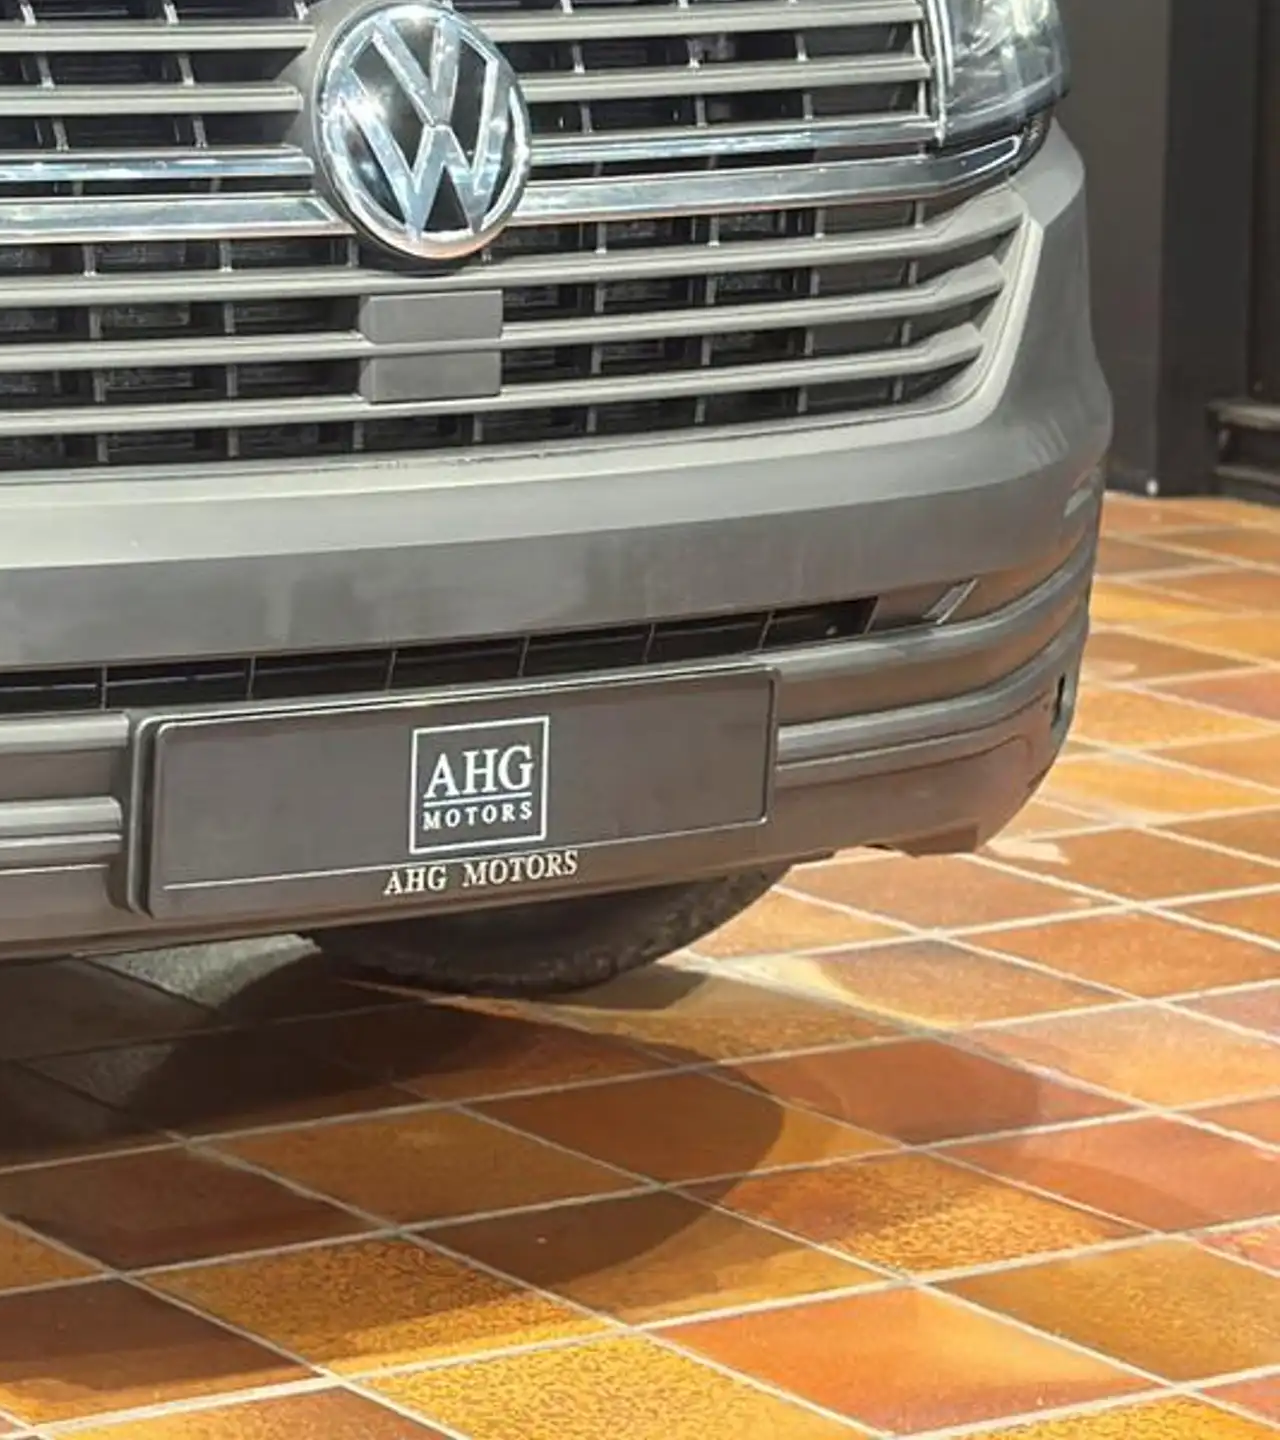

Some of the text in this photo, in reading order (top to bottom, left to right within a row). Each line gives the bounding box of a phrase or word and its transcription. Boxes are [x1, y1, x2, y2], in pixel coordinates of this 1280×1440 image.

[423, 744, 535, 799] AHG
[423, 801, 533, 831] MOTORS
[383, 849, 579, 896] AHG MOTORS
